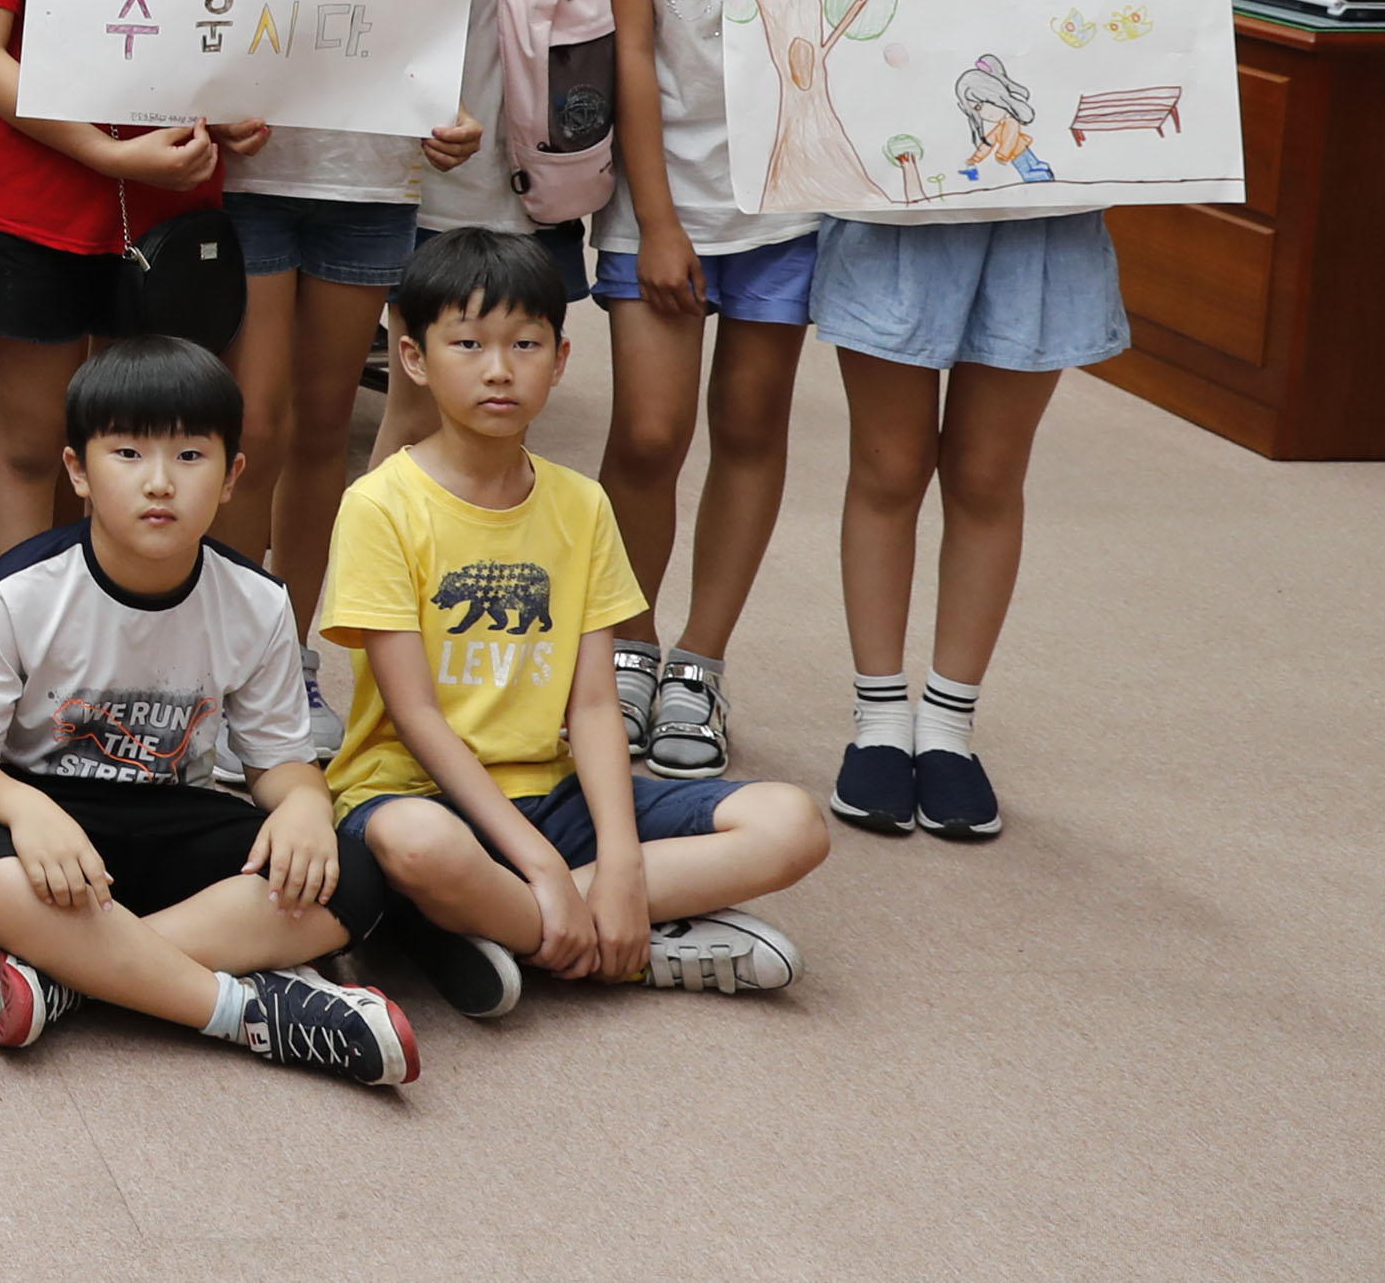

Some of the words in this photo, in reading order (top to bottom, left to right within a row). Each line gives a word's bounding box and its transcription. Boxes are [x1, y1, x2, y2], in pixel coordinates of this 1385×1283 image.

[82, 702, 127, 726] WE
[129, 701, 193, 732] RUN
[104, 732, 160, 762] THE
